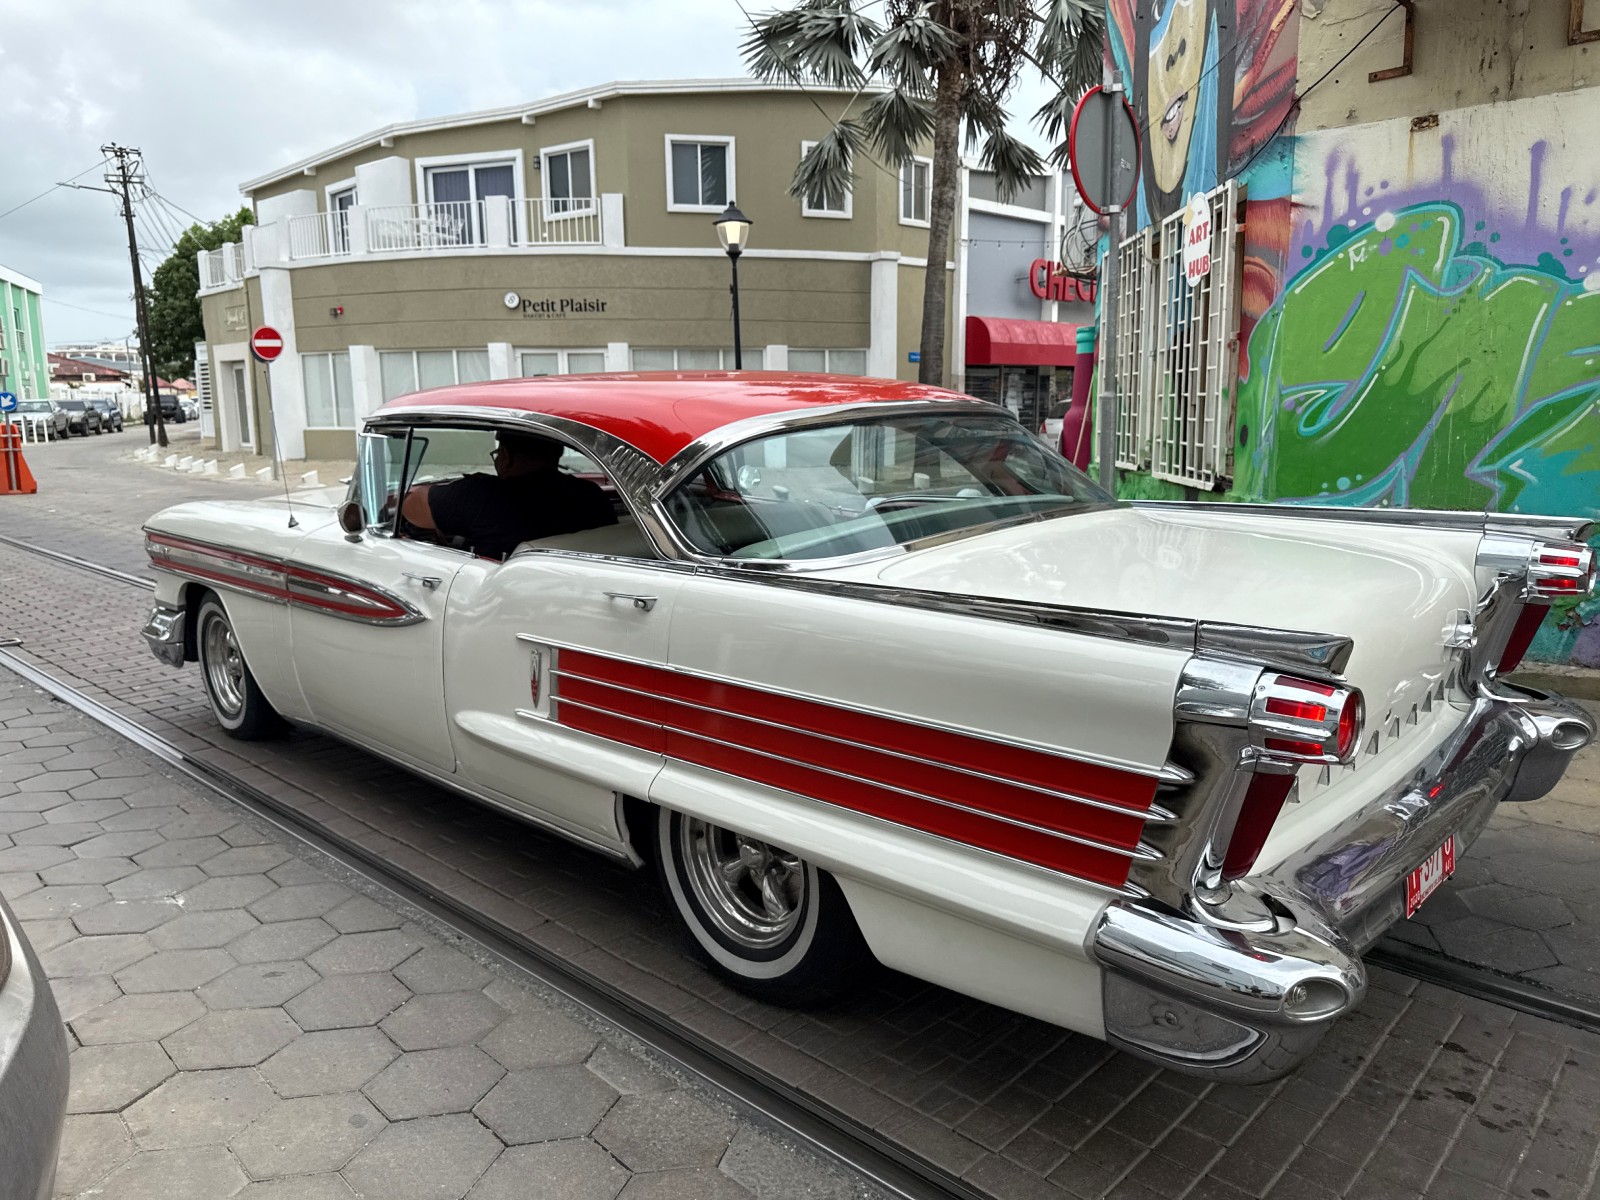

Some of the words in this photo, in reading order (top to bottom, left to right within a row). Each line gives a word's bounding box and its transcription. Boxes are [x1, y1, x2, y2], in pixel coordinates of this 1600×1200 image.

[1189, 221, 1209, 246] ART
[1188, 254, 1209, 279] HUB
[522, 298, 556, 313] Petit
[560, 298, 607, 313] Plaisir
